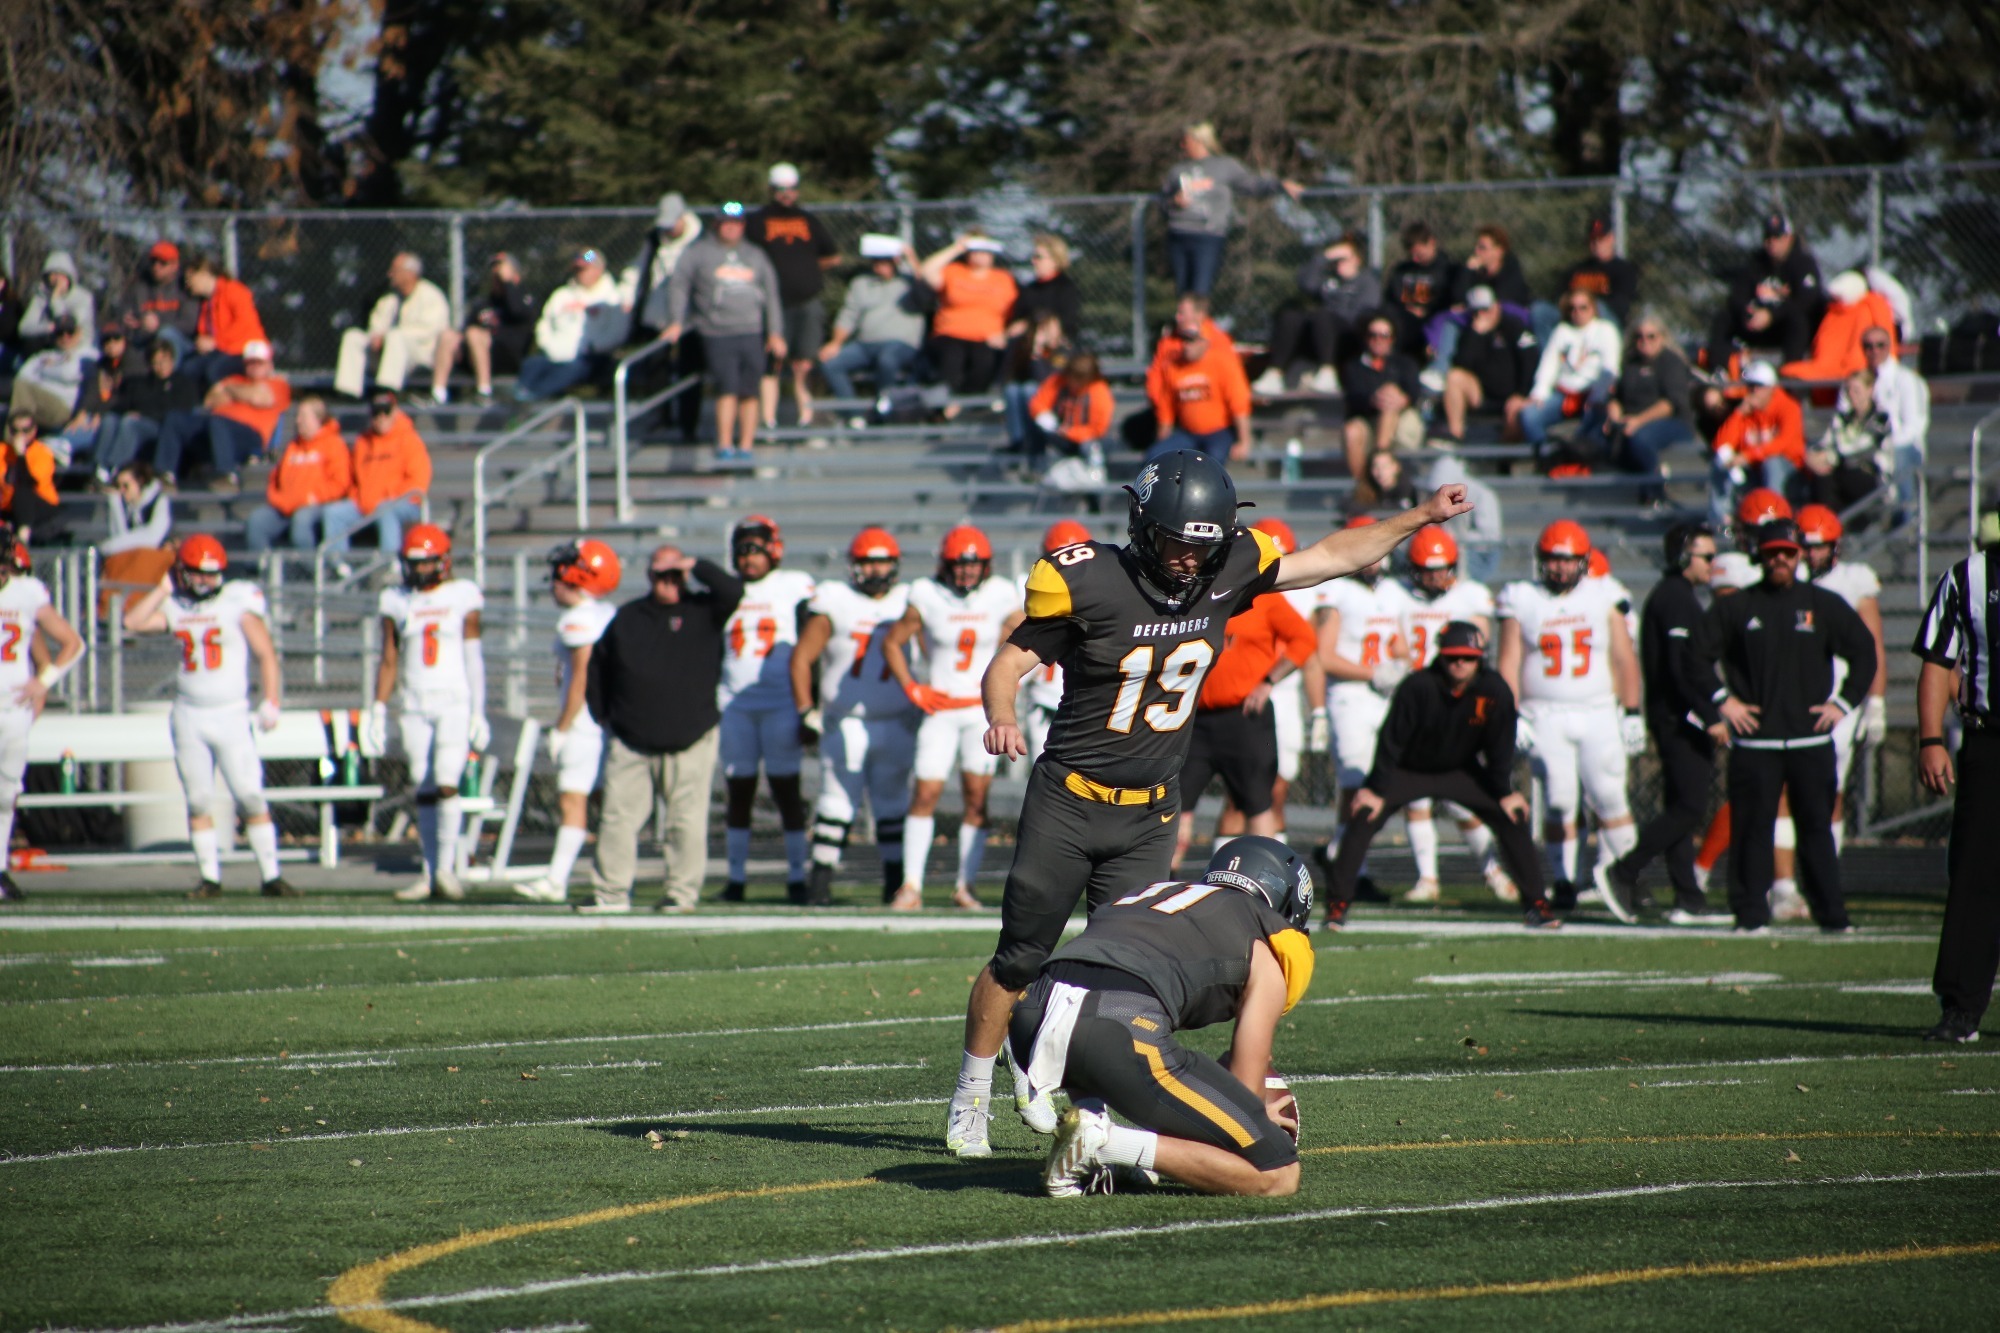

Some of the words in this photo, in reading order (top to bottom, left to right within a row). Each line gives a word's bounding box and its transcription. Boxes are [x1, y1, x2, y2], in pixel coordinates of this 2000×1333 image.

[1051, 543, 1096, 566] 19
[422, 623, 438, 667] 6
[1132, 616, 1210, 637] DEFENDERS
[955, 628, 976, 671] 9
[1540, 628, 1592, 676] 95
[1106, 638, 1215, 734] 19
[1112, 881, 1224, 915] 11
[1206, 872, 1248, 888] DEFENDERS
